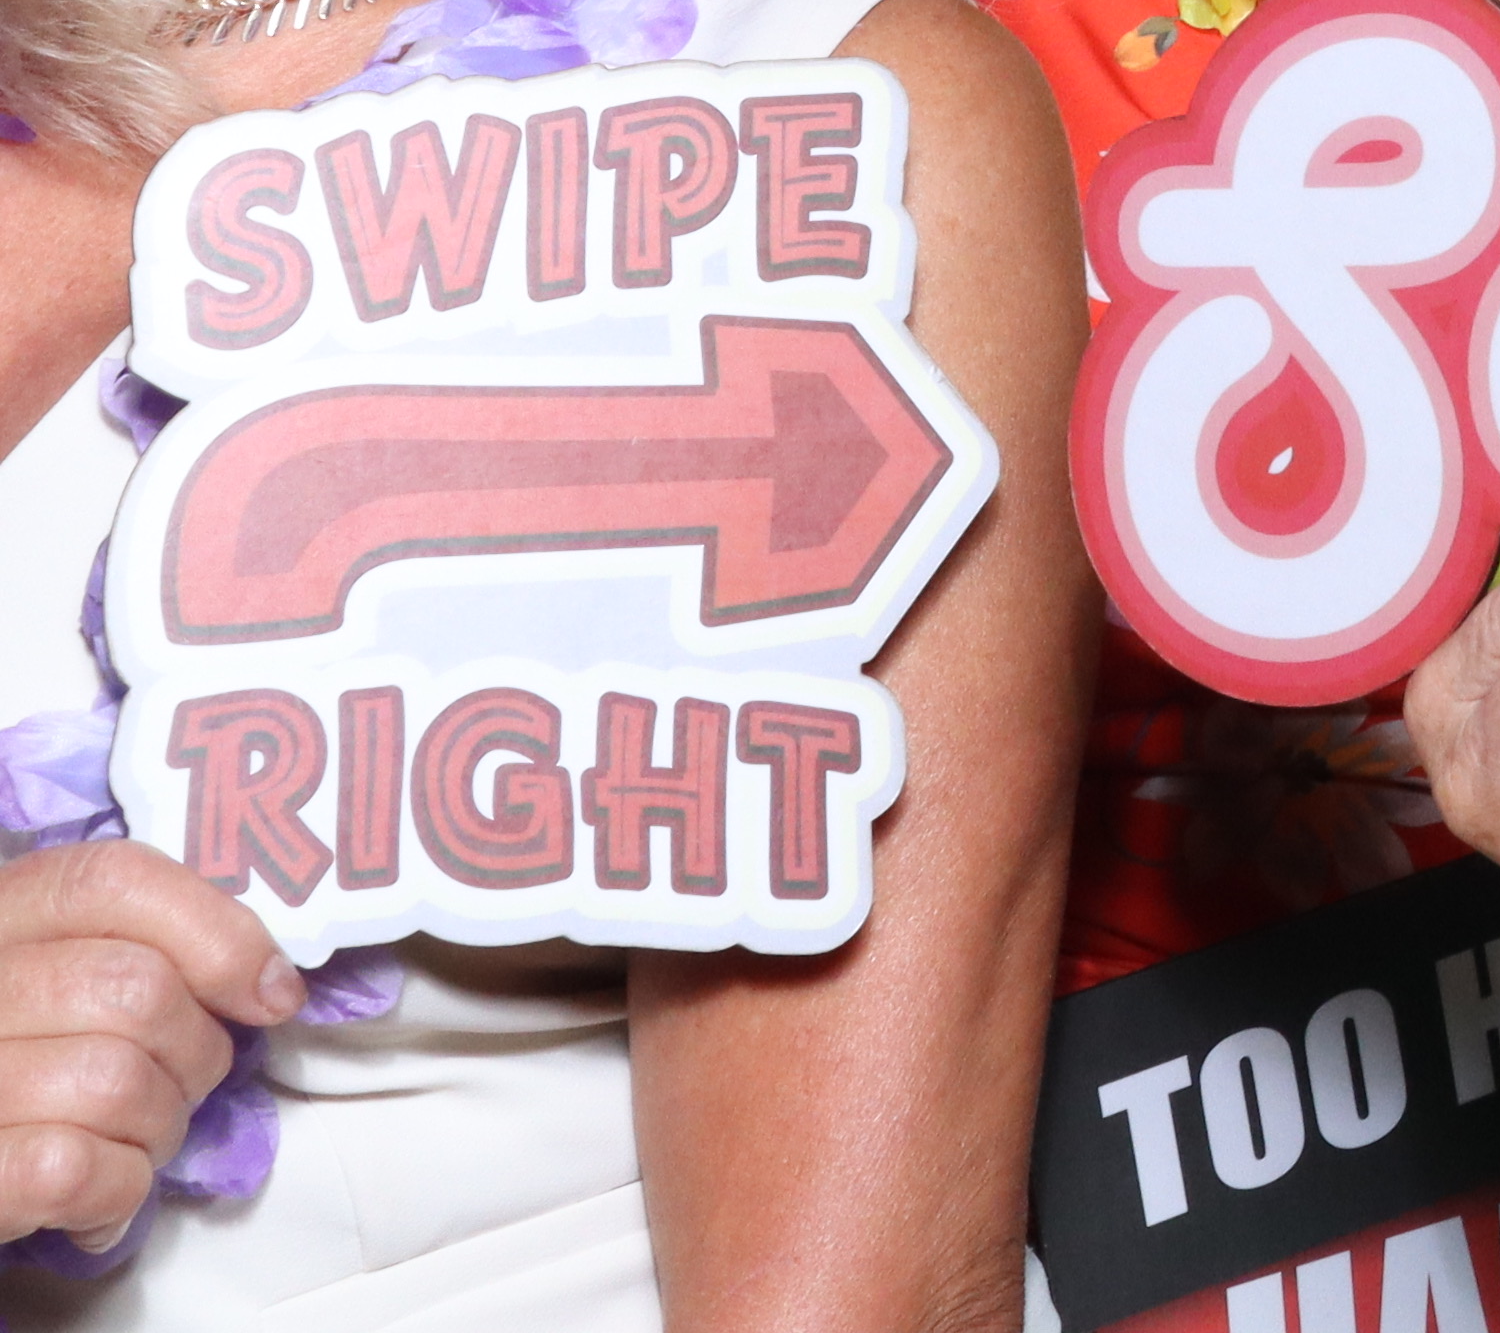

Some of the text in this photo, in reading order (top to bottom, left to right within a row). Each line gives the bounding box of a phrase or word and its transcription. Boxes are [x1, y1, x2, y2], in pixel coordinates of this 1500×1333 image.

[184, 91, 871, 350] SWIPE
[164, 684, 862, 907] RIGHT
[1097, 986, 1408, 1228] TOO
